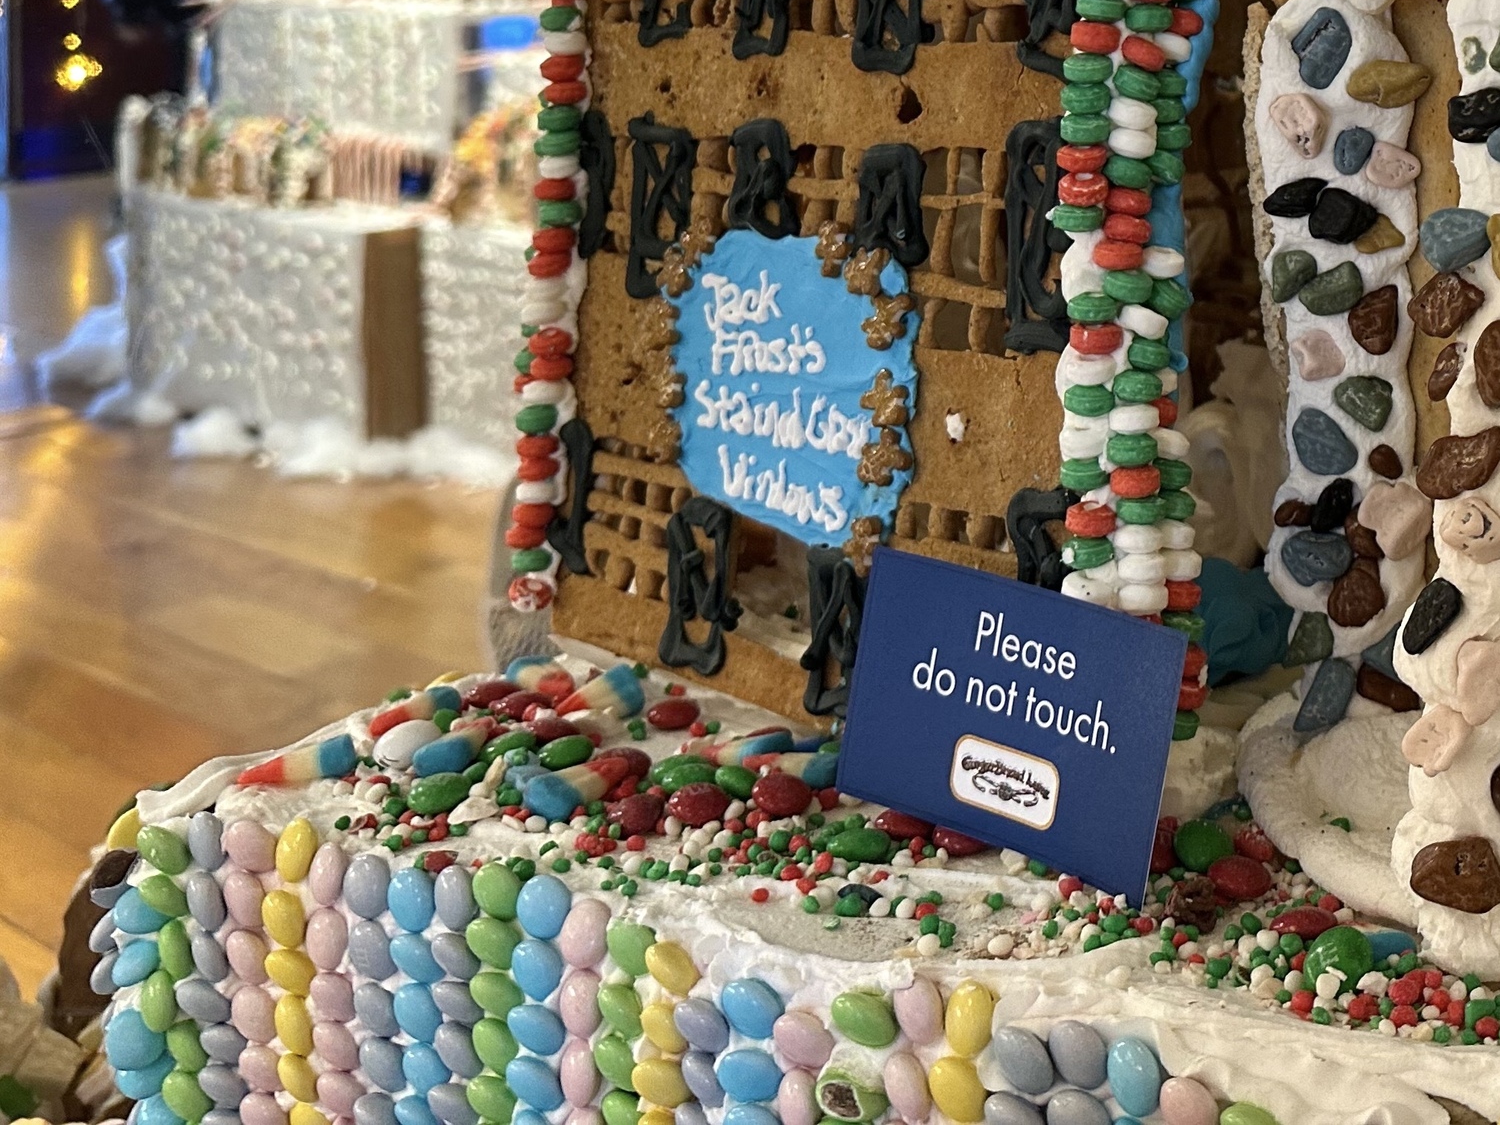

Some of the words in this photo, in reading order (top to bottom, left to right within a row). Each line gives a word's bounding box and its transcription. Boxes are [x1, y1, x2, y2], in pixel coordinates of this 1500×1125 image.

[702, 270, 782, 331] Jack
[974, 611, 1077, 681] Please
[912, 647, 956, 697] do
[965, 676, 1018, 717] not
[1025, 686, 1116, 754] touch.
